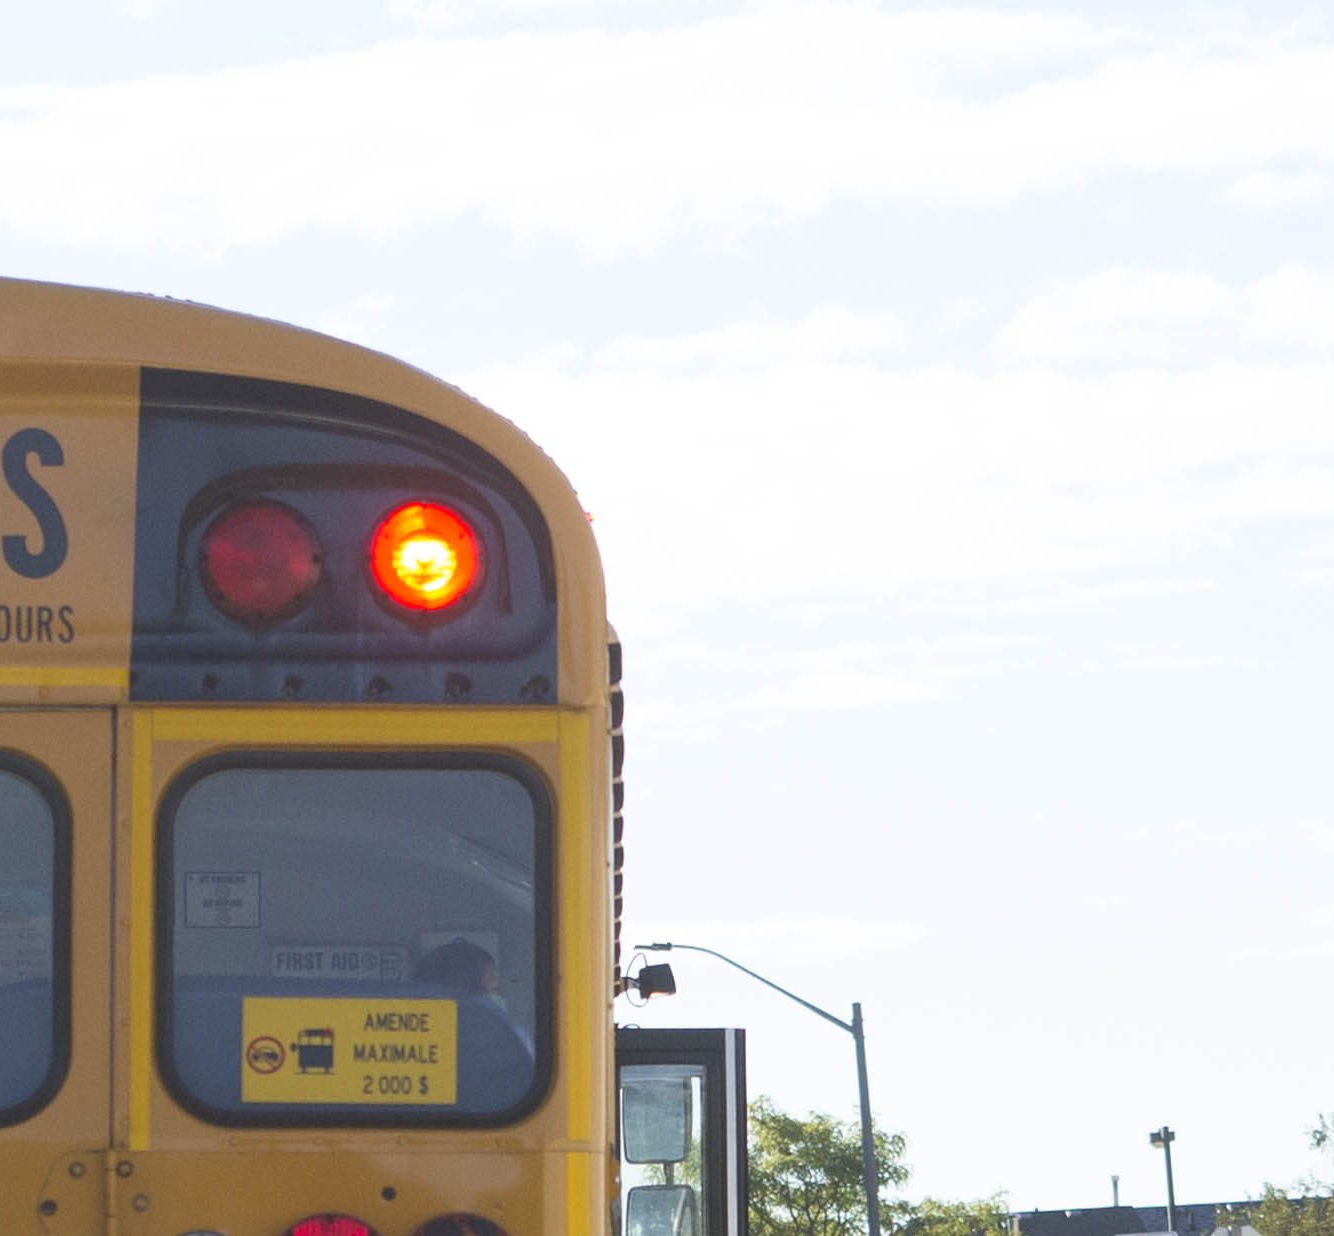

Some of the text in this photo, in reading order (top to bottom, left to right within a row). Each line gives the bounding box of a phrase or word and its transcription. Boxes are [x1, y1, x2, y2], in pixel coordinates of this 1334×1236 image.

[275, 952, 323, 971] FIRST
[330, 952, 359, 971] AID
[363, 1013, 430, 1032] AMENDE
[353, 1044, 439, 1064] MAXIMALE
